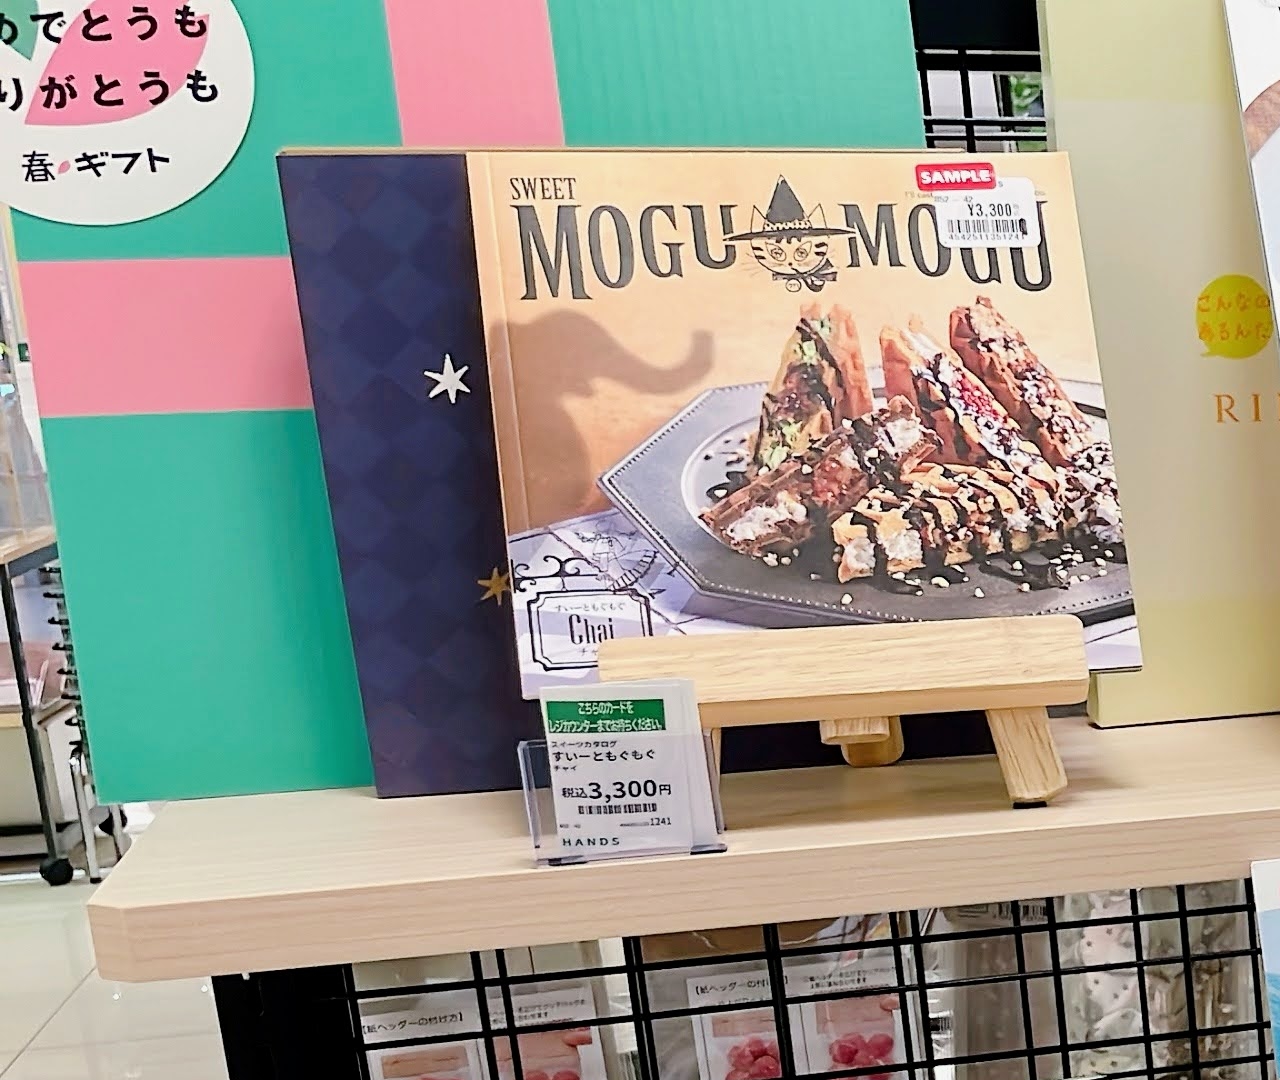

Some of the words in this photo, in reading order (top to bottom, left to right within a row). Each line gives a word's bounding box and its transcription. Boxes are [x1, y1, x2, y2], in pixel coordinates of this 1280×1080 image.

[920, 169, 994, 186] SAMPLE
[510, 177, 577, 200] SWEET
[511, 204, 738, 300] MOGU
[553, 750, 656, 762] すいーともぐもぐ
[562, 837, 620, 846] HANDS
